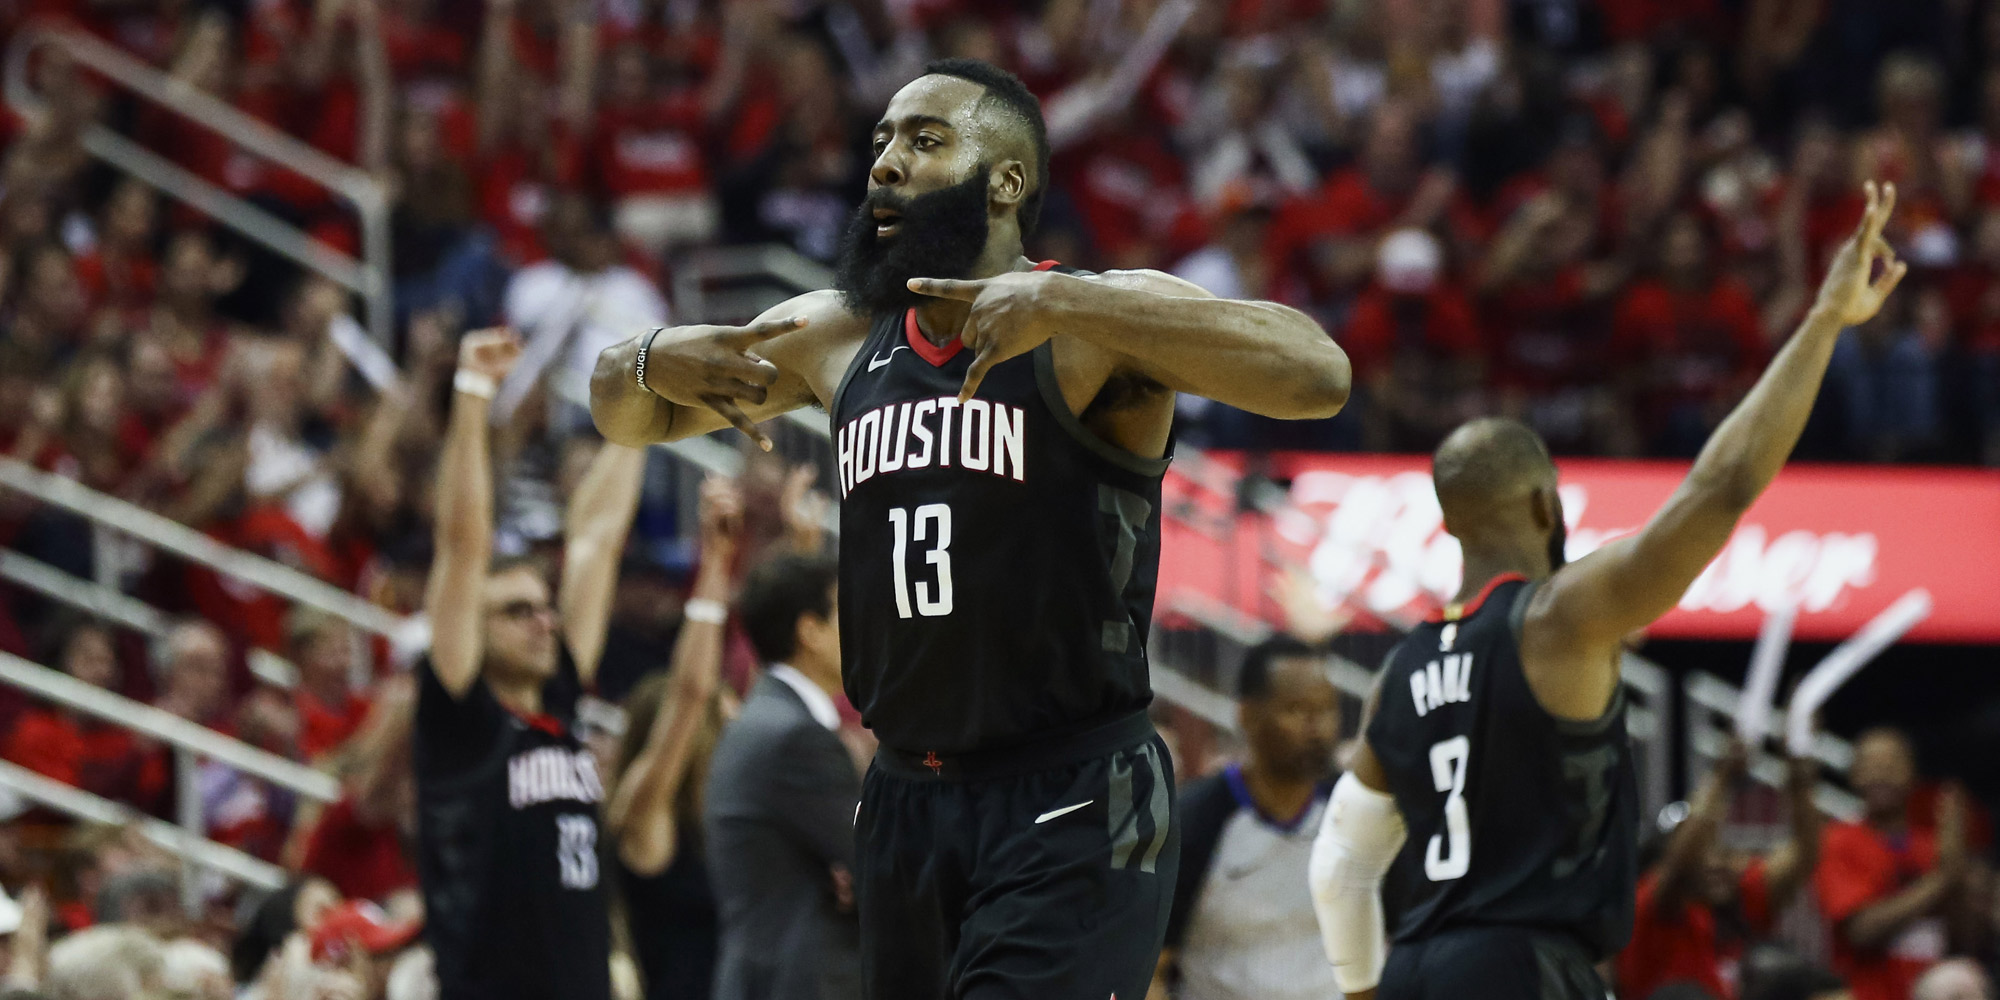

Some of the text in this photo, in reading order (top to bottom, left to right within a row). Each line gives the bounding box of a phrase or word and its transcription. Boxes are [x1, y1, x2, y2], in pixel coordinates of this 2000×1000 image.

[838, 396, 1025, 500] HOUSTON
[888, 503, 953, 618] 13
[1410, 652, 1473, 717] PAUL
[555, 814, 599, 890] 13
[1424, 734, 1471, 881] 3
